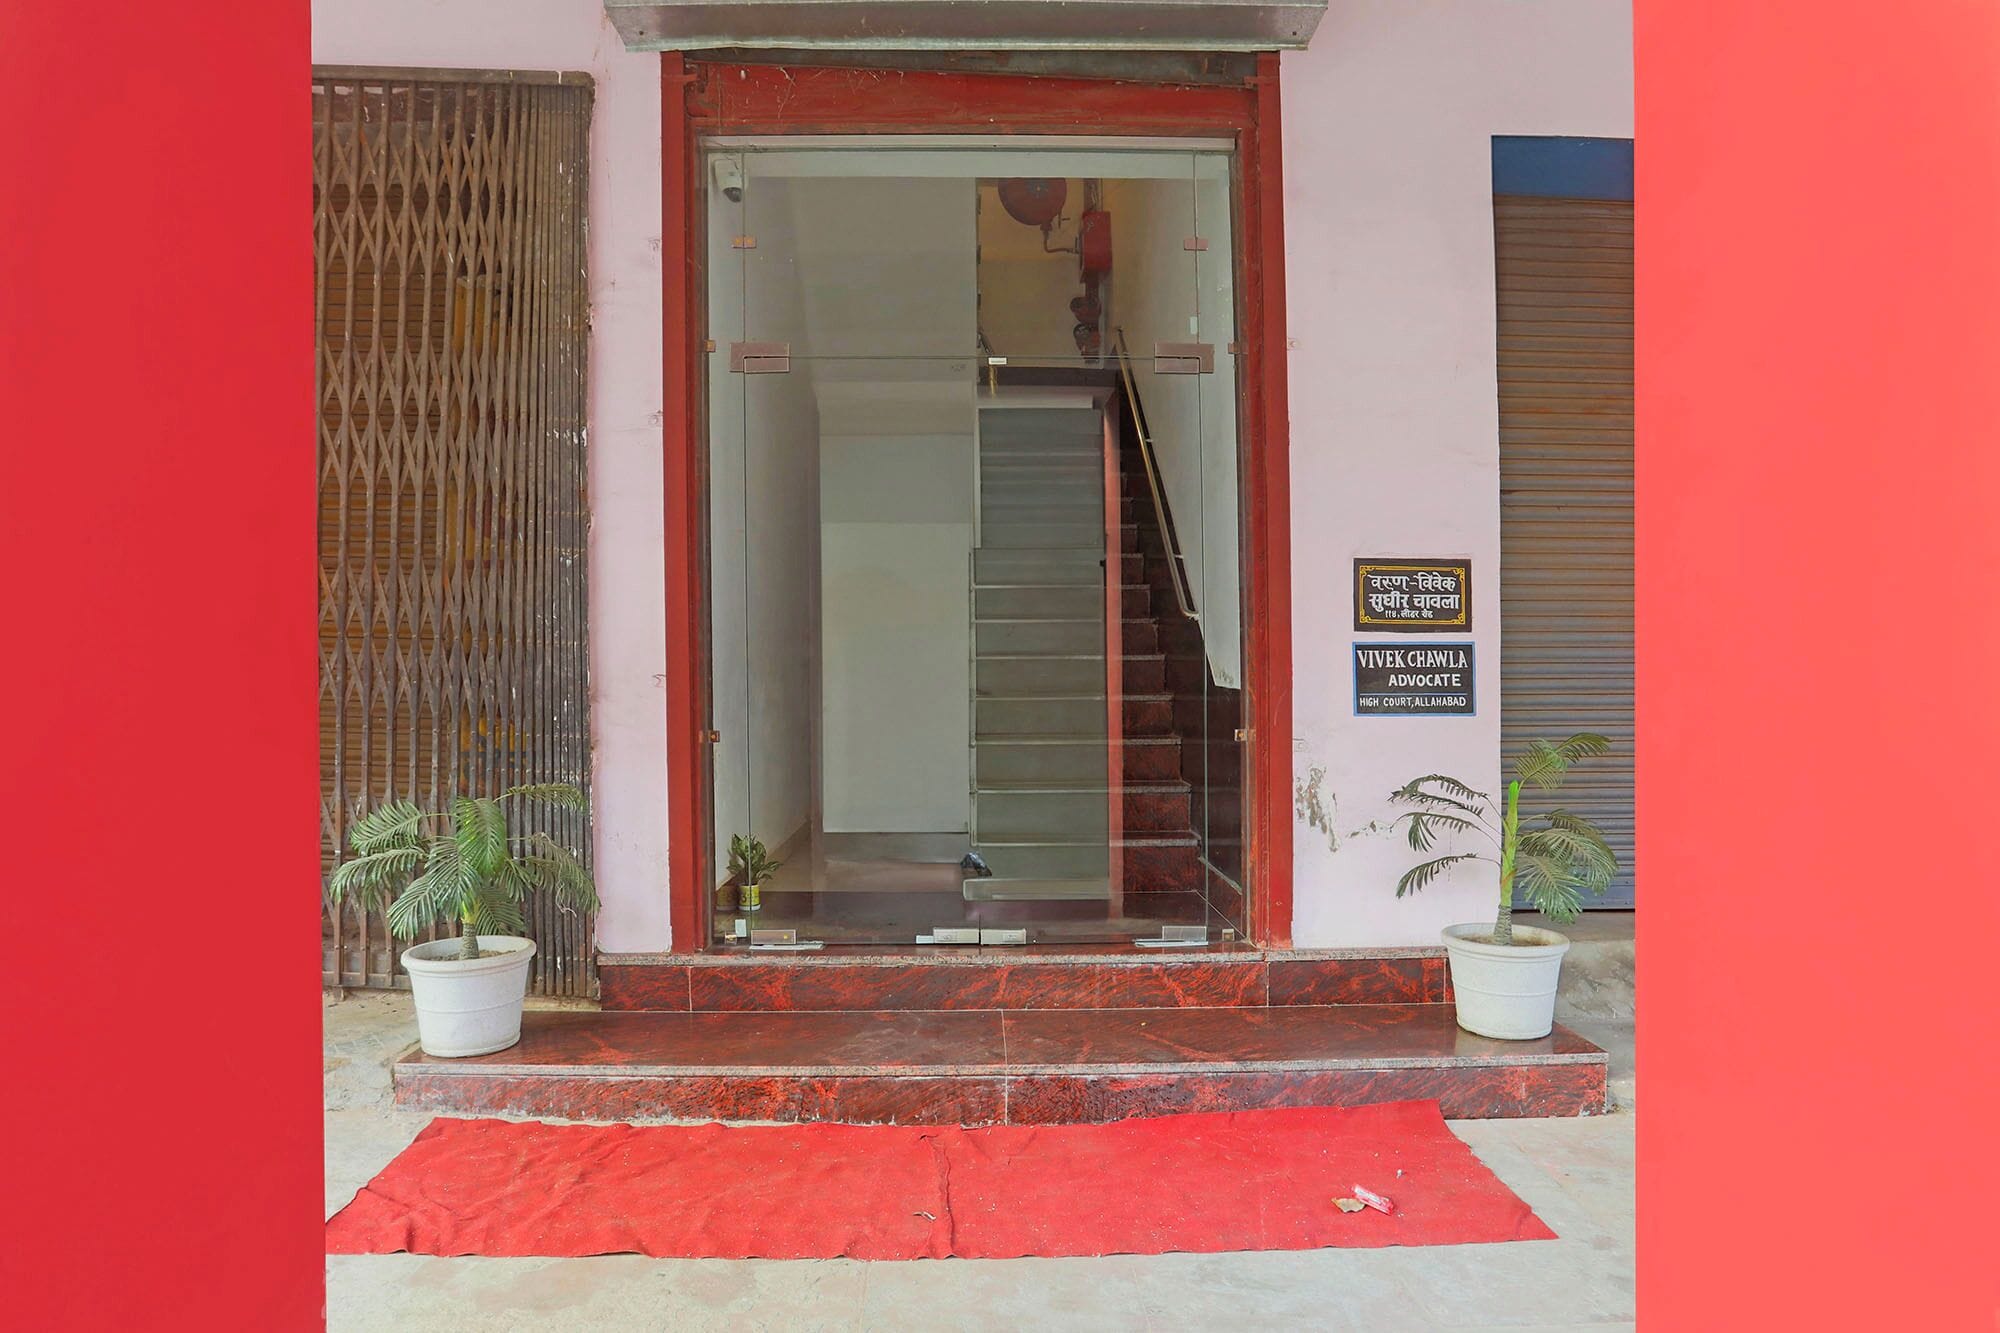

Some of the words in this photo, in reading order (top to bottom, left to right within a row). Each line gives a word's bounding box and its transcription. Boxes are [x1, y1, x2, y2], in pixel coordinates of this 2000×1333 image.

[1368, 591, 1410, 612] सुधीर
[1413, 594, 1461, 610] चावला
[1357, 650, 1406, 669] VIVEK
[1407, 650, 1469, 669] CHAWLA
[1388, 673, 1462, 687] ADVOCATE
[1359, 697, 1379, 707] HIGH
